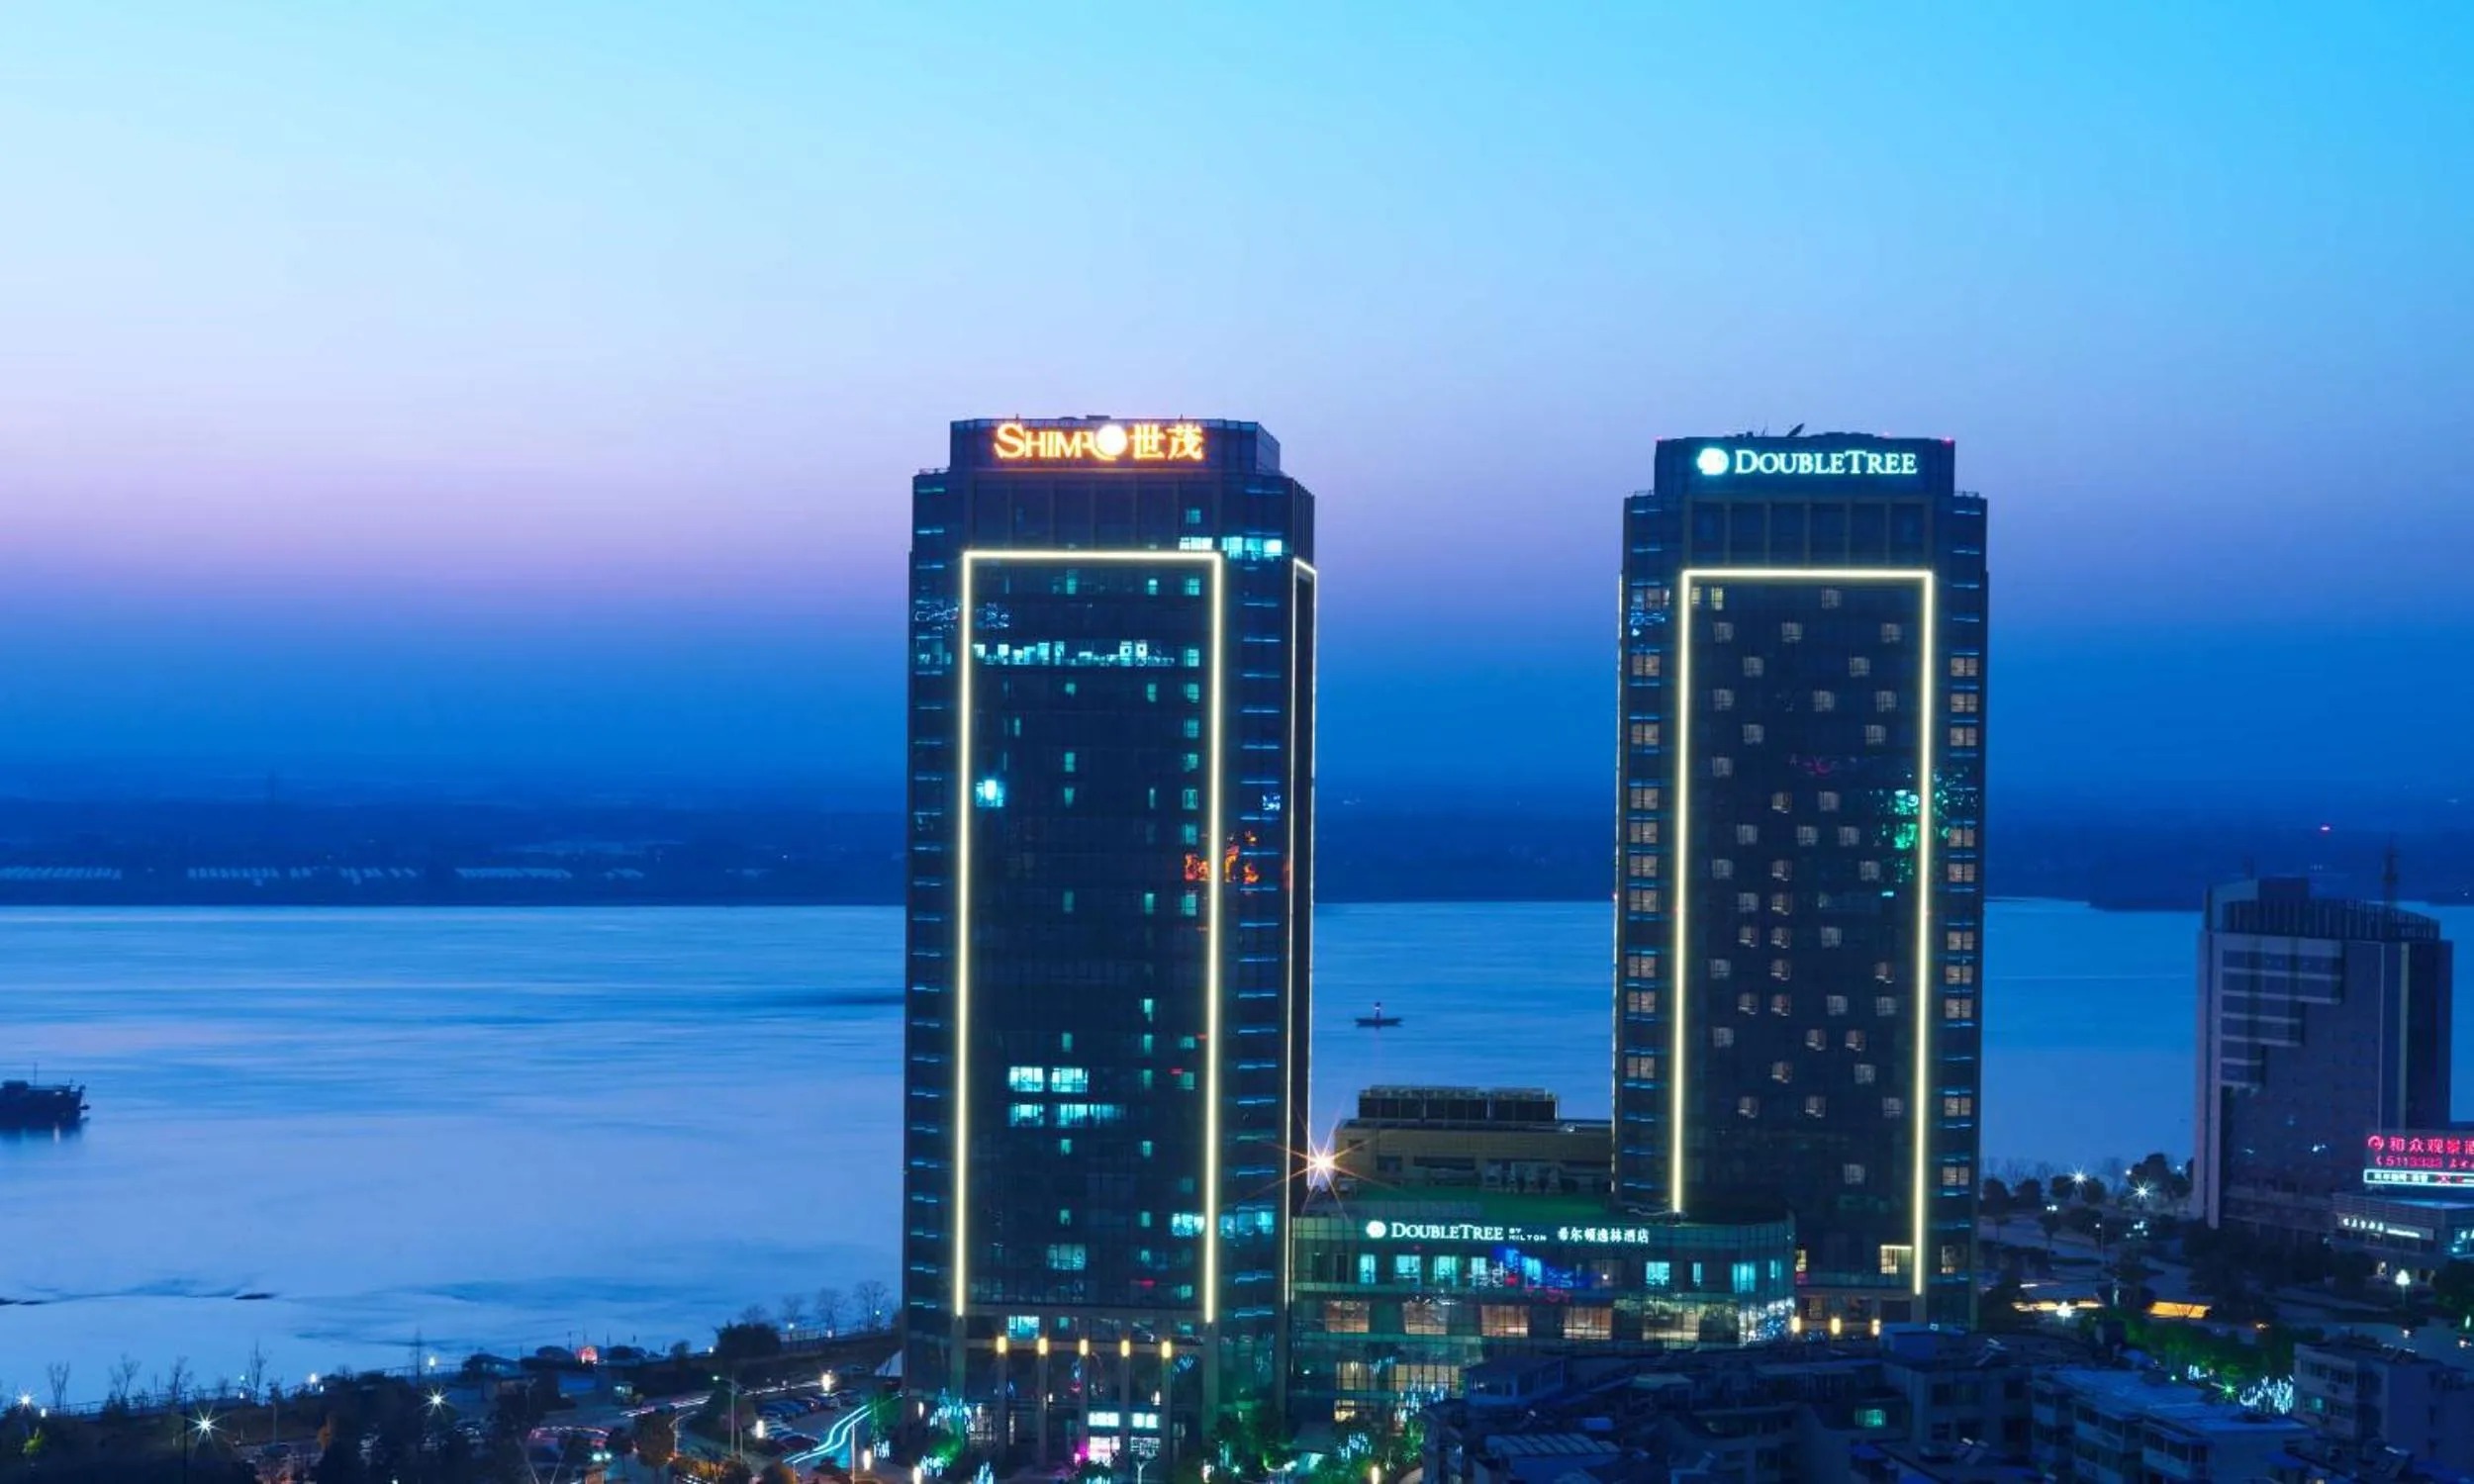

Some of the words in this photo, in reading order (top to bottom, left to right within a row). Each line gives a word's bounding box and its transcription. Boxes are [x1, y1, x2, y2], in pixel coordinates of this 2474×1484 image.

[1130, 423, 1203, 460] 世茂
[1558, 1227, 1649, 1244] 希尔顿逸林酒店
